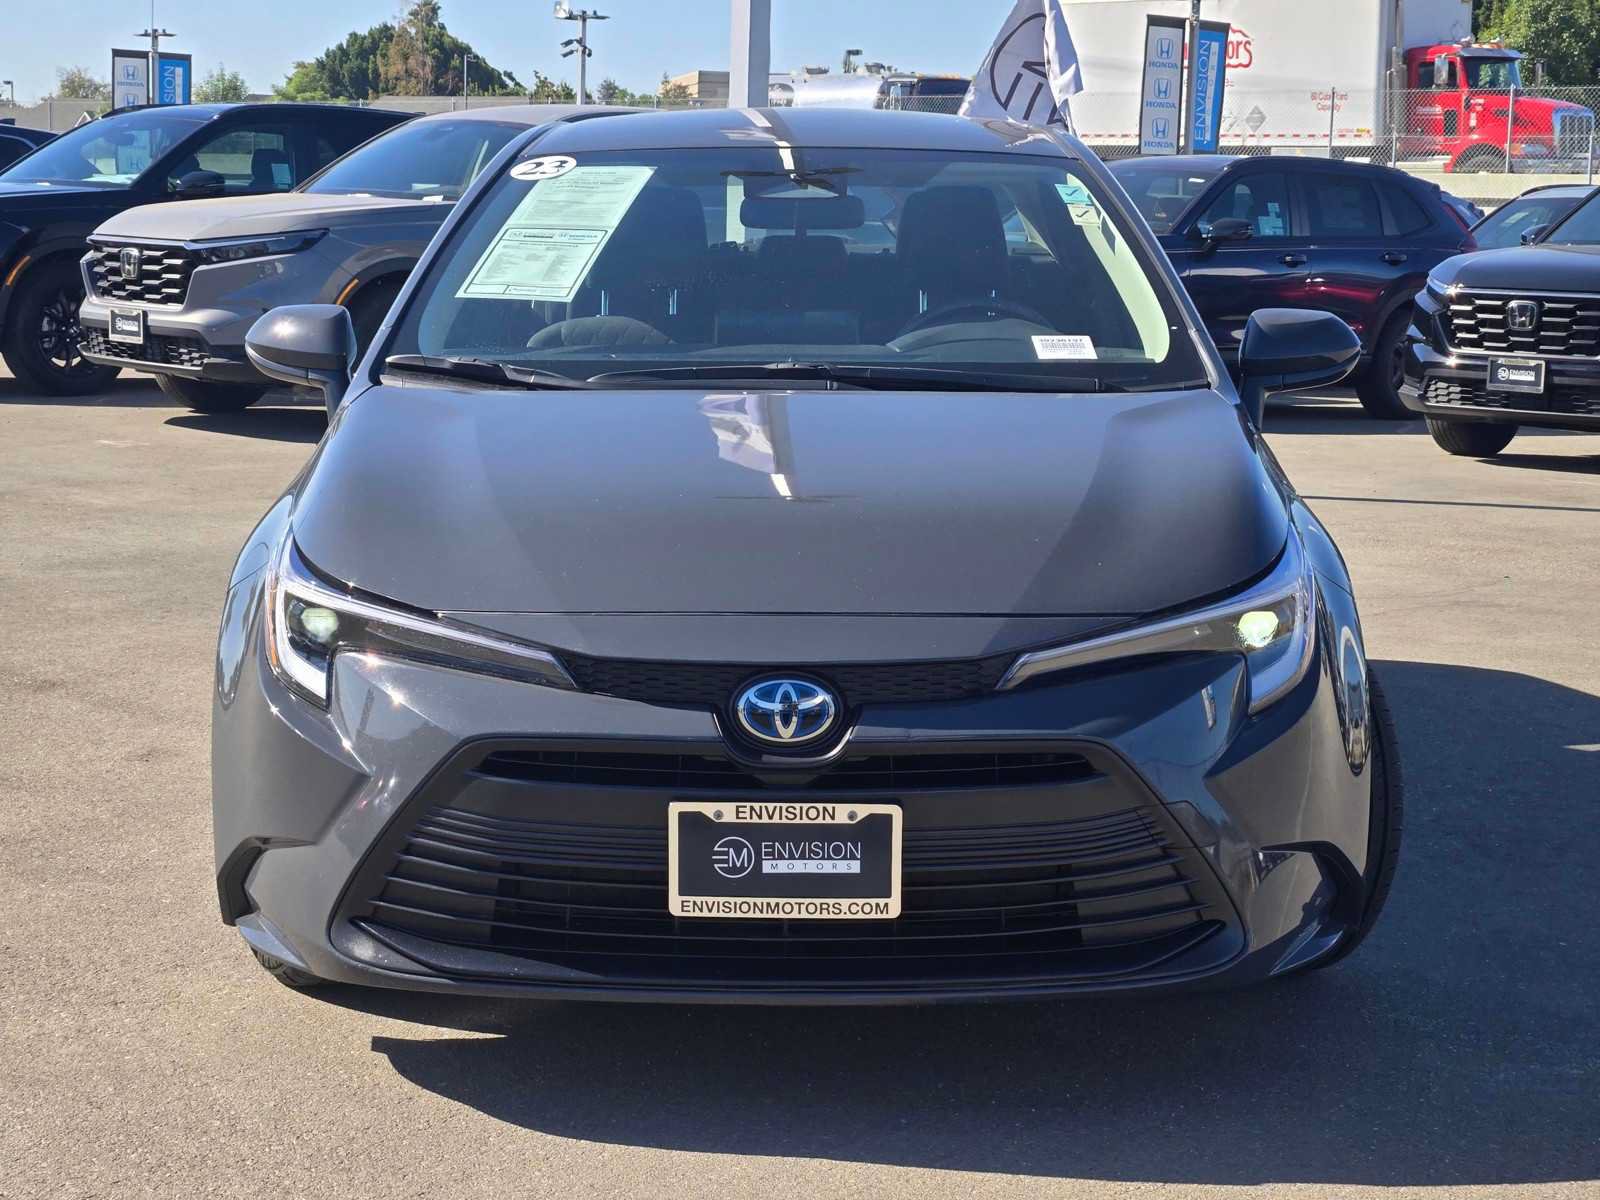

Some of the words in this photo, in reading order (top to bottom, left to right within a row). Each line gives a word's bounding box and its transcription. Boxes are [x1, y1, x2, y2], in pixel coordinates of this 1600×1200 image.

[1149, 60, 1178, 69] HONDA
[1194, 40, 1210, 140] ENVISION
[1145, 100, 1176, 109] HONDA
[1143, 140, 1175, 149] HONDA
[735, 805, 836, 821] ENVISION
[761, 841, 861, 859] ENVISION
[770, 862, 853, 871] MOTORS
[680, 900, 890, 915] ENVISIONMOTORS.COM
